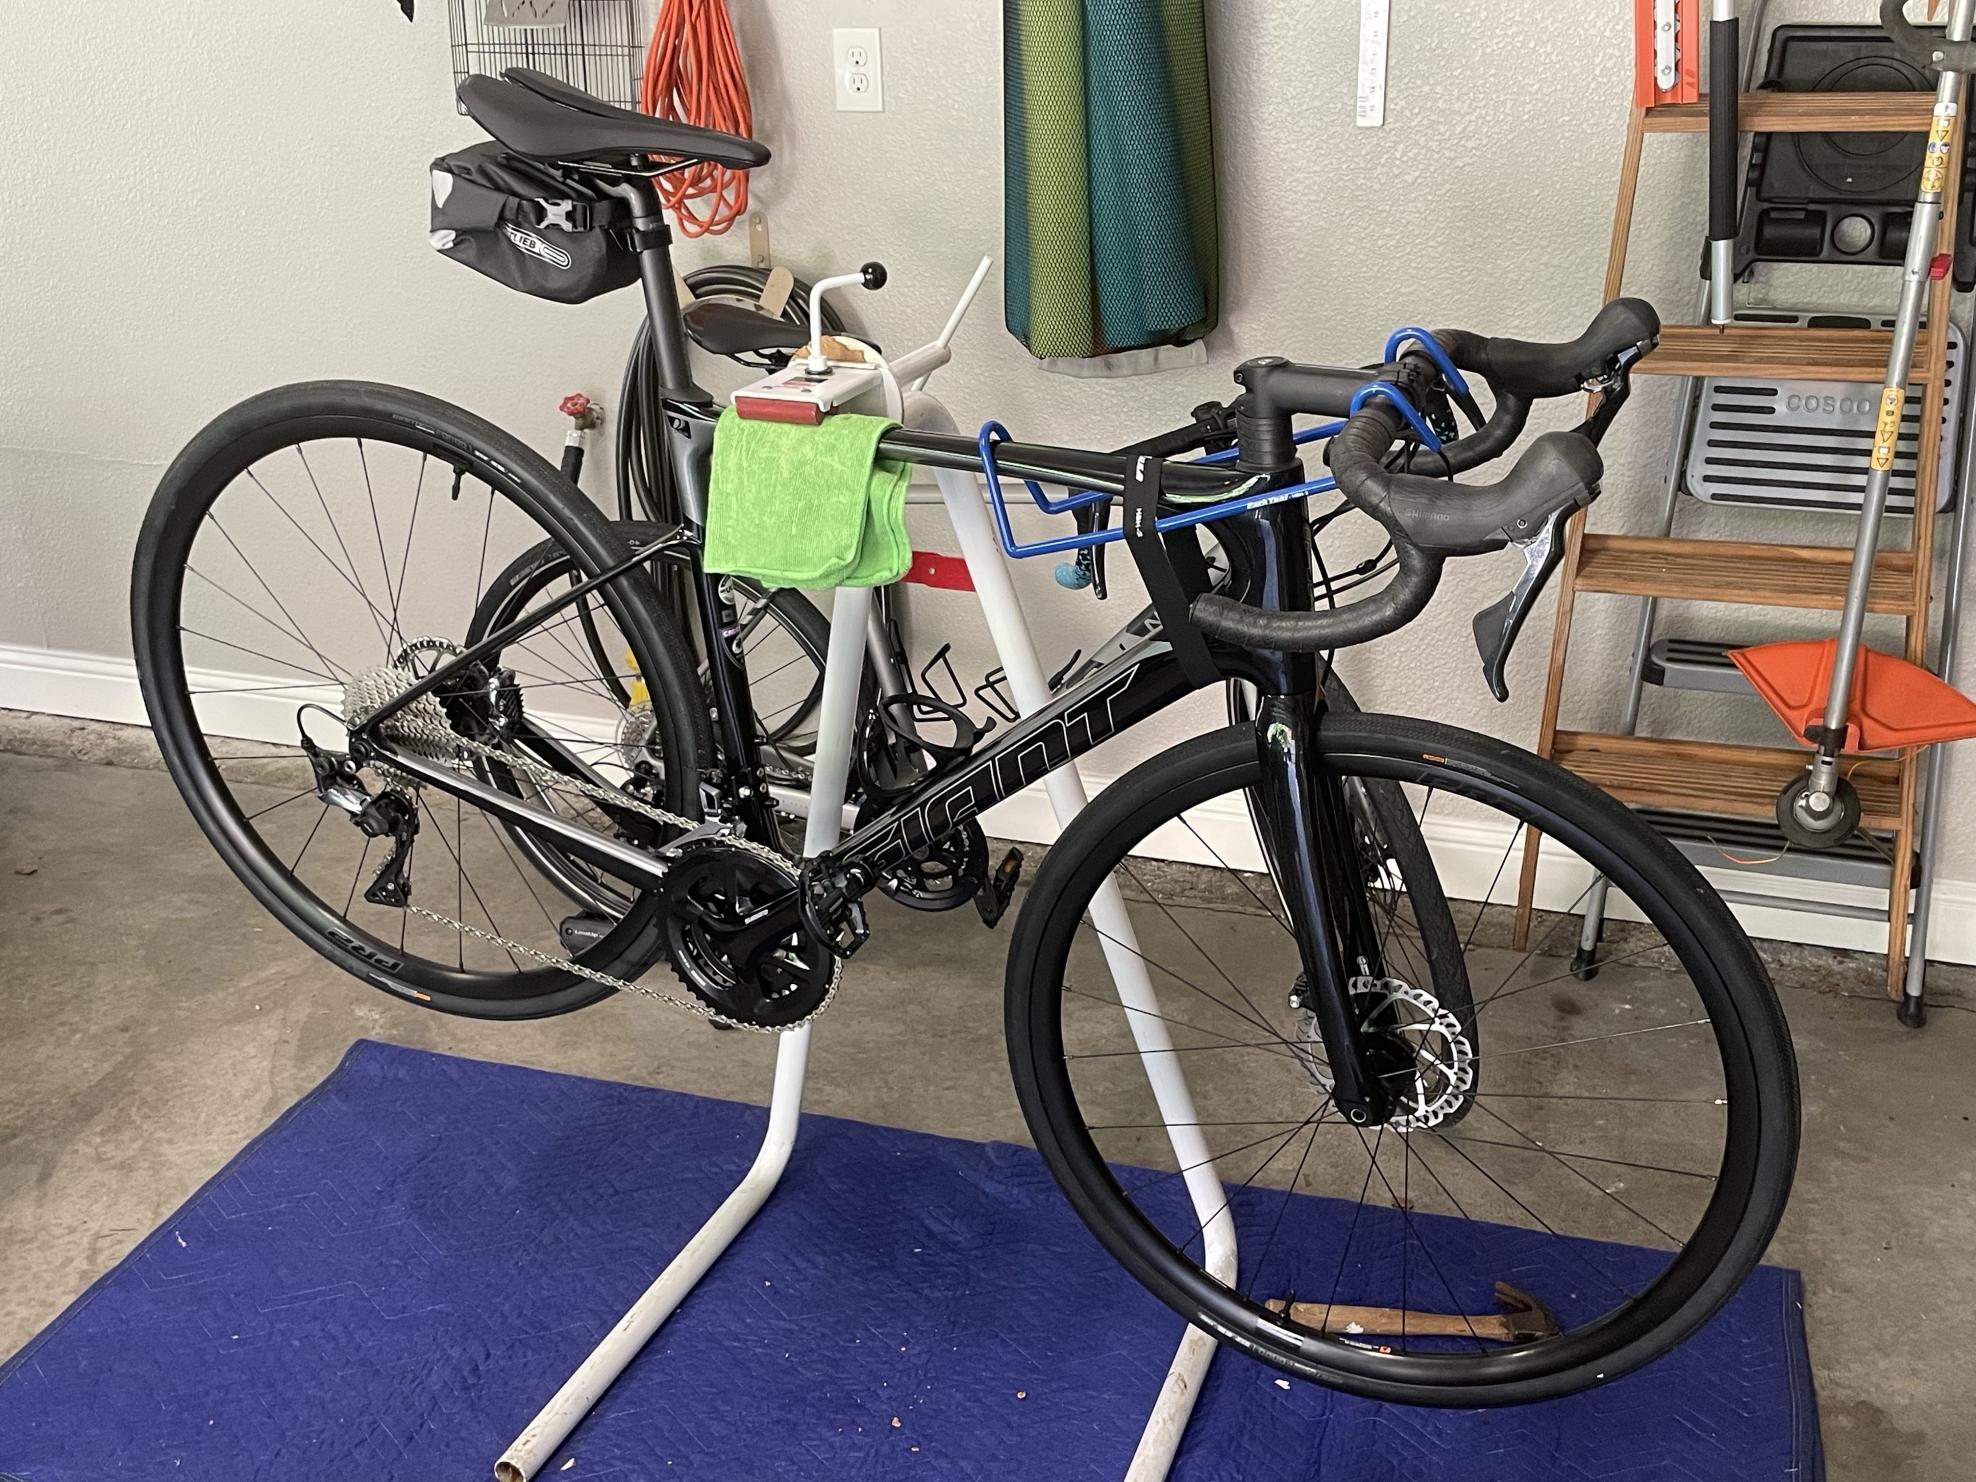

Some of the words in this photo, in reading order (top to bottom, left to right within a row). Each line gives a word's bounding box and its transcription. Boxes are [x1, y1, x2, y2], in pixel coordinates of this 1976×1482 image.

[1785, 394, 1873, 417] COSCO
[1405, 508, 1451, 522] SHIMANO
[840, 662, 1141, 870] GIANT
[327, 931, 402, 972] PR2
